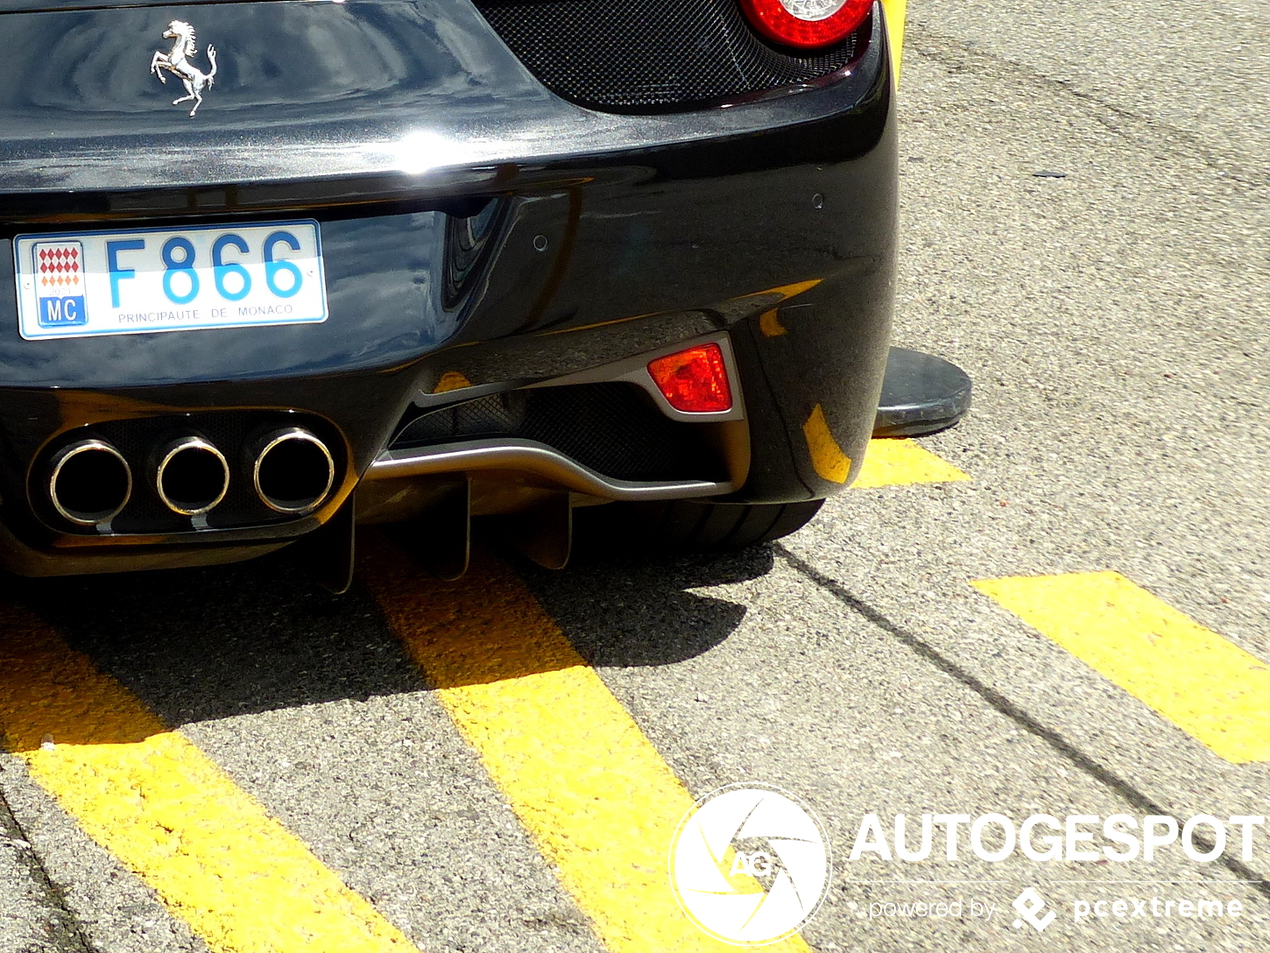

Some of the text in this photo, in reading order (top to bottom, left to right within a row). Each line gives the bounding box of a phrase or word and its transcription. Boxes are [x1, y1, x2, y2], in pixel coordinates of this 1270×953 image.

[46, 299, 77, 323] MC
[118, 304, 294, 324] PRINCIPAUTE DE MONACO
